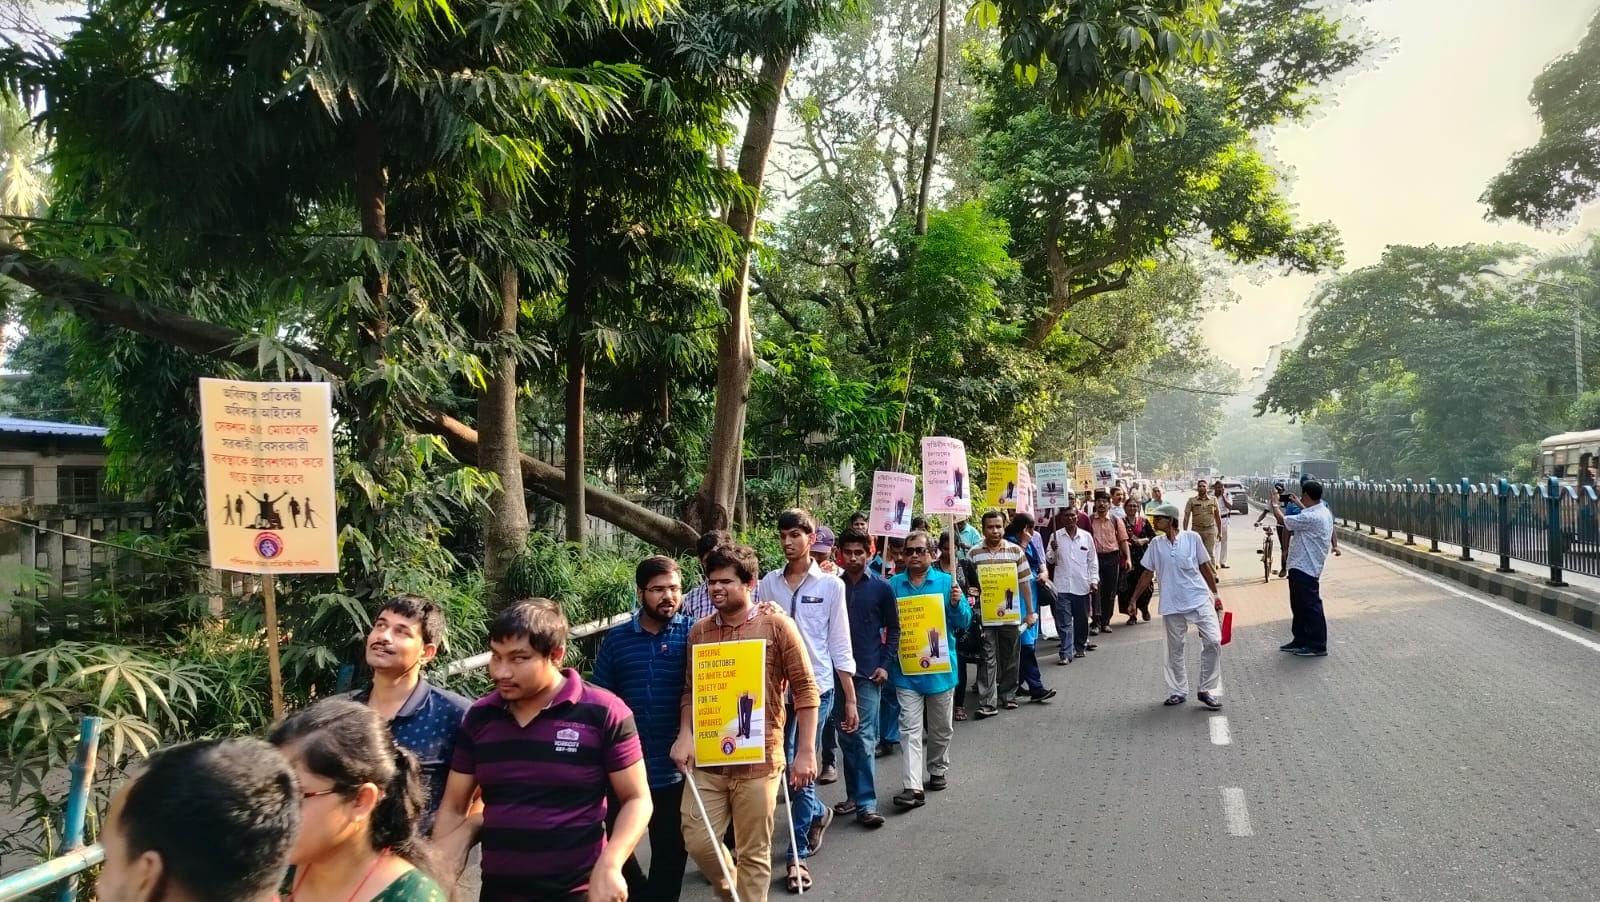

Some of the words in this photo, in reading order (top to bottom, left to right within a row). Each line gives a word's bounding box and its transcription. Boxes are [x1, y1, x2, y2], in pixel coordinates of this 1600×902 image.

[261, 388, 302, 402] প্রতিবন্ধী
[224, 403, 257, 418] অধিকার
[260, 406, 302, 420] আইনের
[268, 424, 320, 436] মোতাবেক
[301, 458, 324, 468] করে
[282, 474, 304, 484] হবে
[698, 649, 720, 658] OBSERVE
[698, 660, 711, 669] 15TH
[712, 659, 735, 668] OCTOBER
[698, 672, 705, 680] AS
[706, 671, 721, 680] WHITE
[722, 670, 736, 678] CANE
[698, 684, 716, 692] SAFETY
[698, 707, 721, 716] VISUALLY
[699, 718, 722, 727] IMPAIRED
